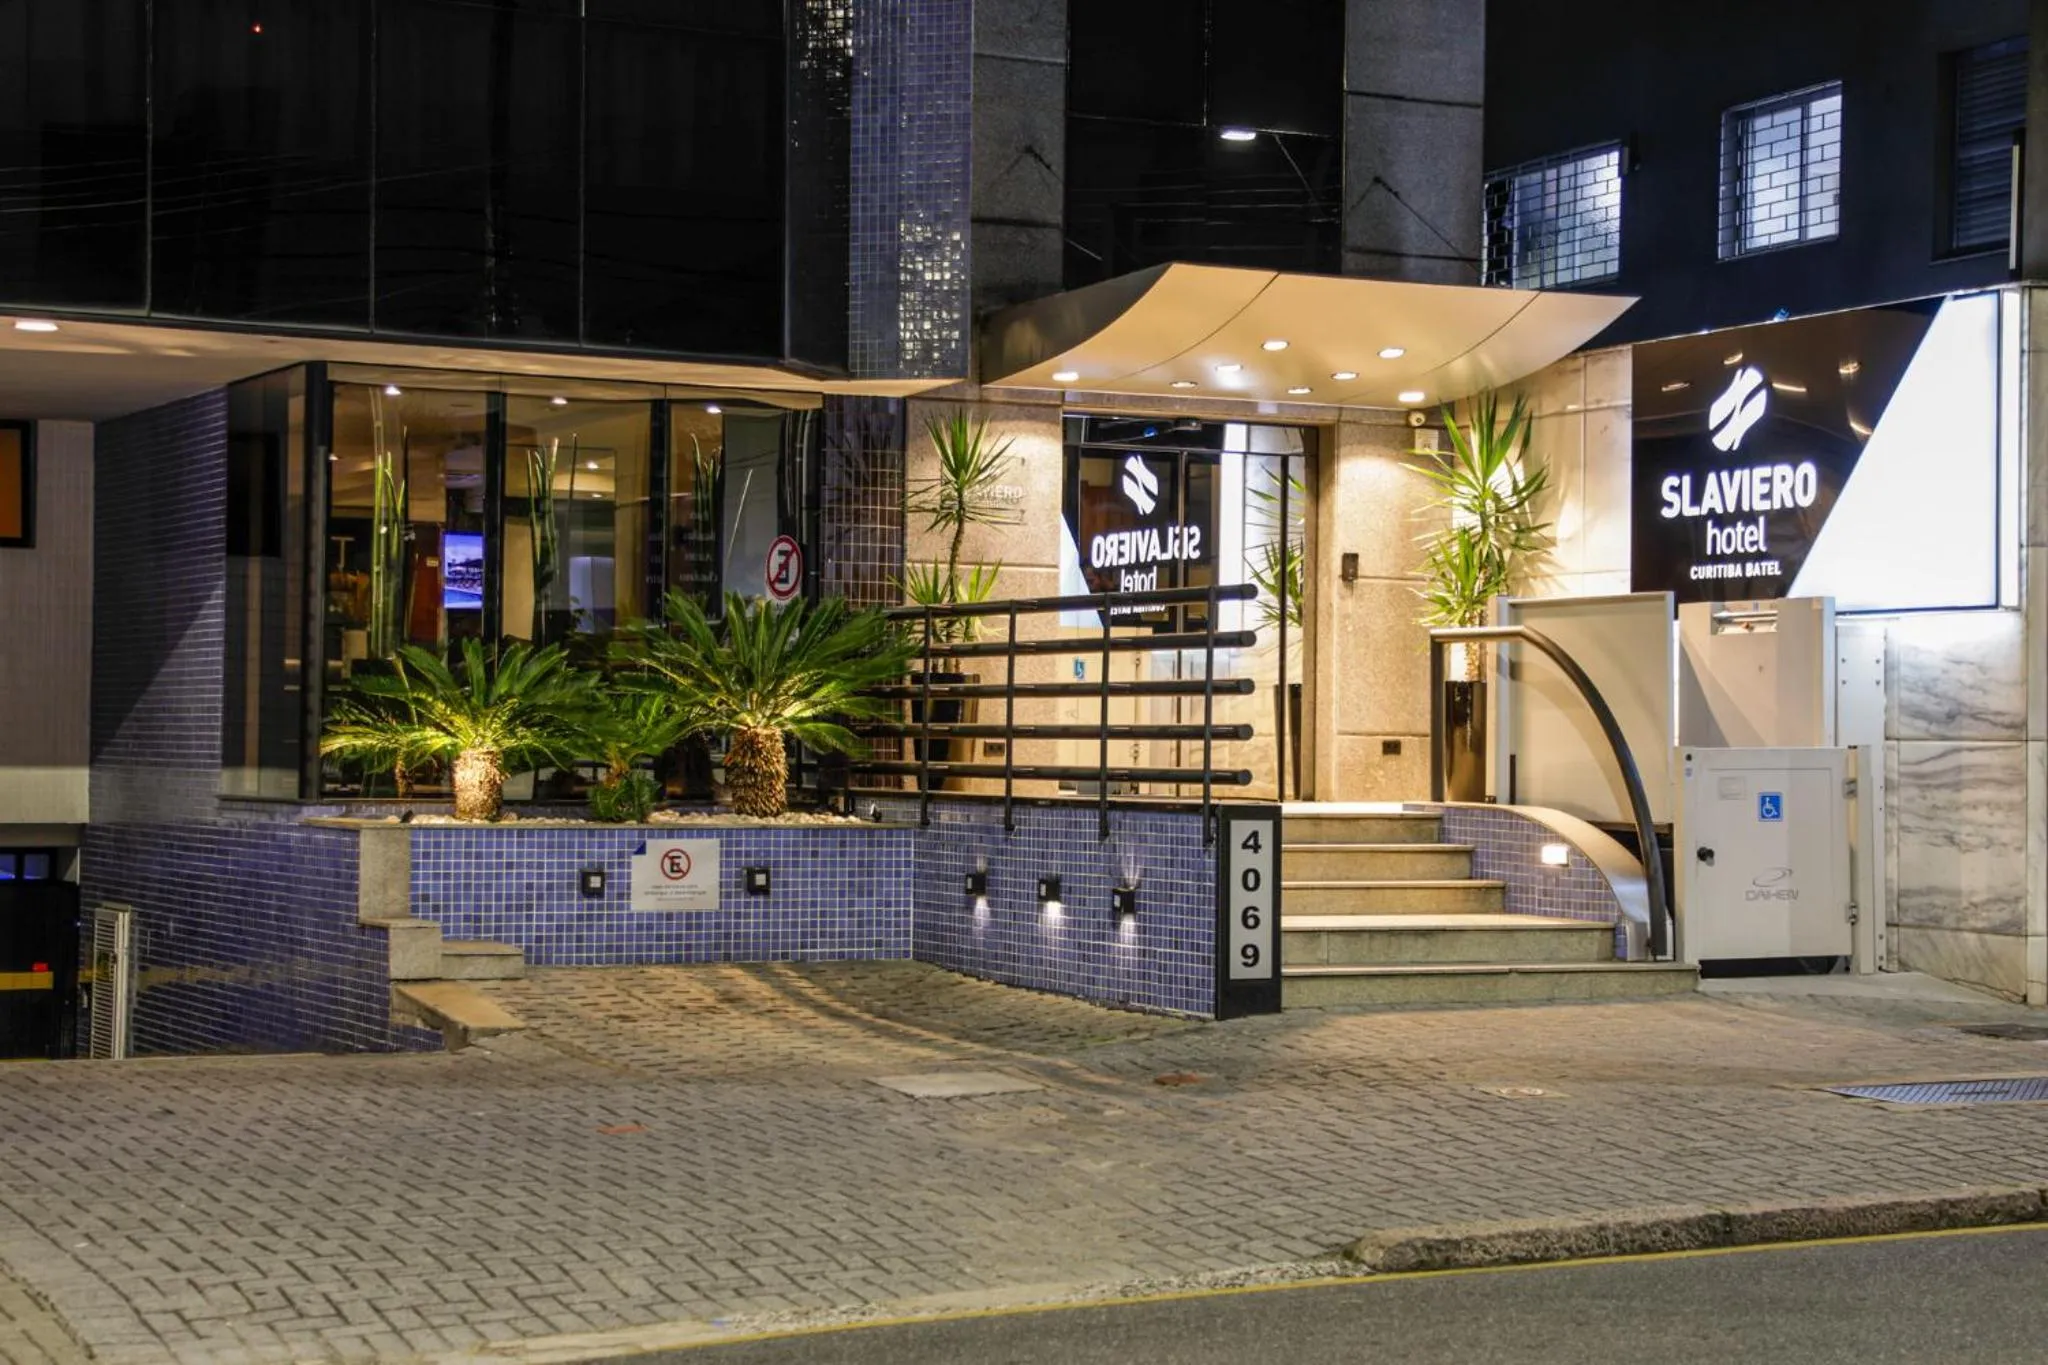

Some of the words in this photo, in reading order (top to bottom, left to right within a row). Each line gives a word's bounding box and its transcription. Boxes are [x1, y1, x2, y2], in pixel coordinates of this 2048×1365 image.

[1661, 461, 1817, 518] SLAVIERO
[1706, 516, 1768, 556] hotel
[1690, 562, 1743, 580] CURITIBA
[1745, 560, 1782, 577] BATEL
[1240, 829, 1262, 968] 4069
